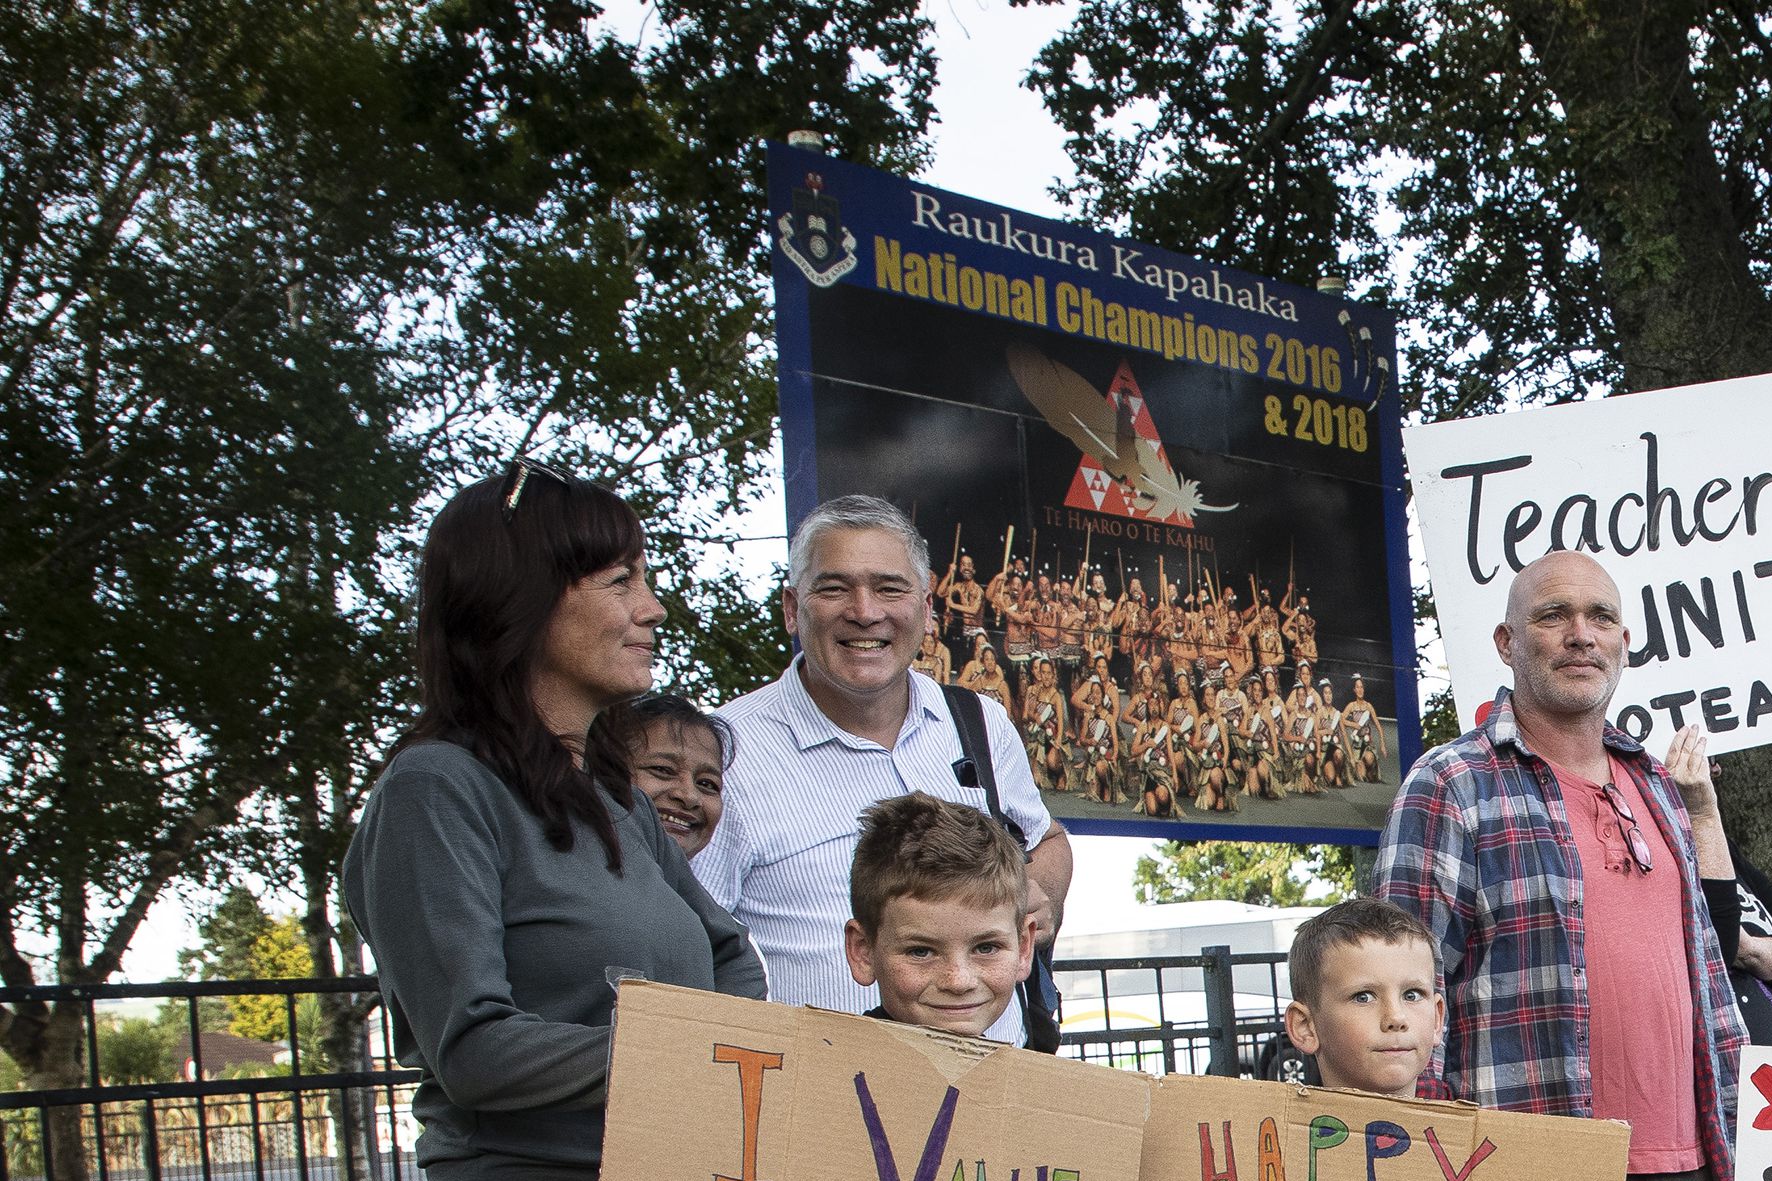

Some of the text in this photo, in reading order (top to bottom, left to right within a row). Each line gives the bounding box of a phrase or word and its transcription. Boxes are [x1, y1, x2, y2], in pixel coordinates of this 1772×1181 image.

[910, 190, 1298, 323] Raukura Kapahaka
[874, 235, 1343, 394] National Champions 2016
[1264, 396, 1369, 454] & 2018
[1126, 523, 1139, 540] O
